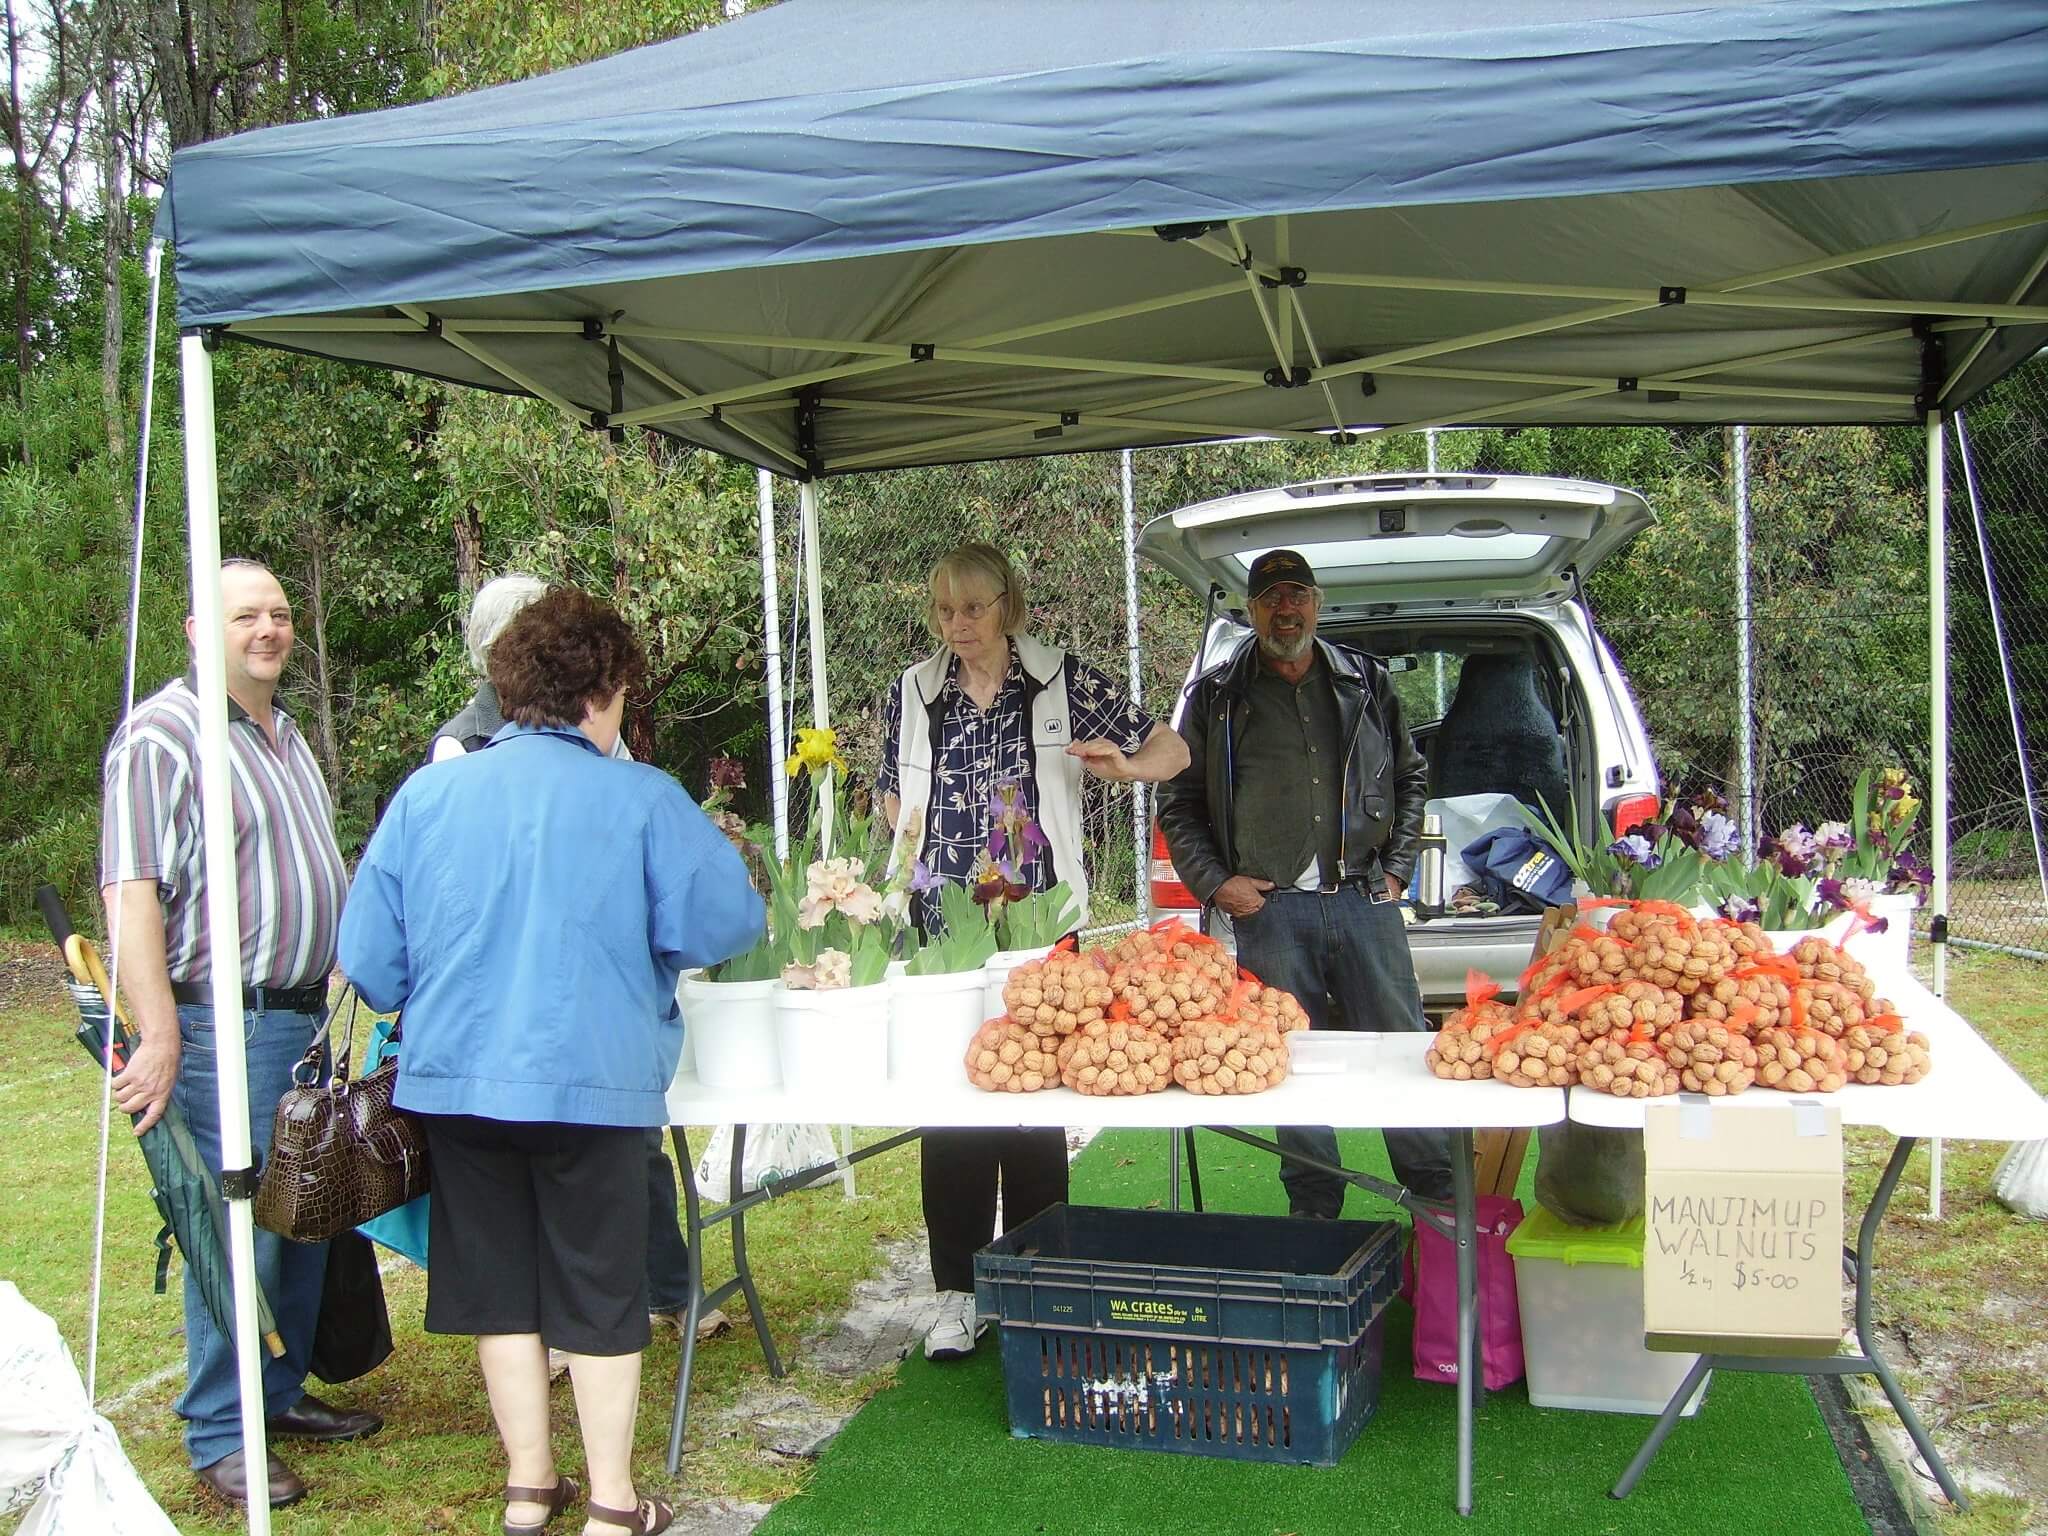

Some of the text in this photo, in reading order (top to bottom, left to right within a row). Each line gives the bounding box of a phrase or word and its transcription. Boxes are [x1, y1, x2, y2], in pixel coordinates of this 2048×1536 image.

[1651, 1195, 1826, 1229] MANJIMUP
[1654, 1227, 1816, 1261] WALNUTS
[1110, 1299, 1129, 1312] WA
[1131, 1300, 1174, 1315] crates
